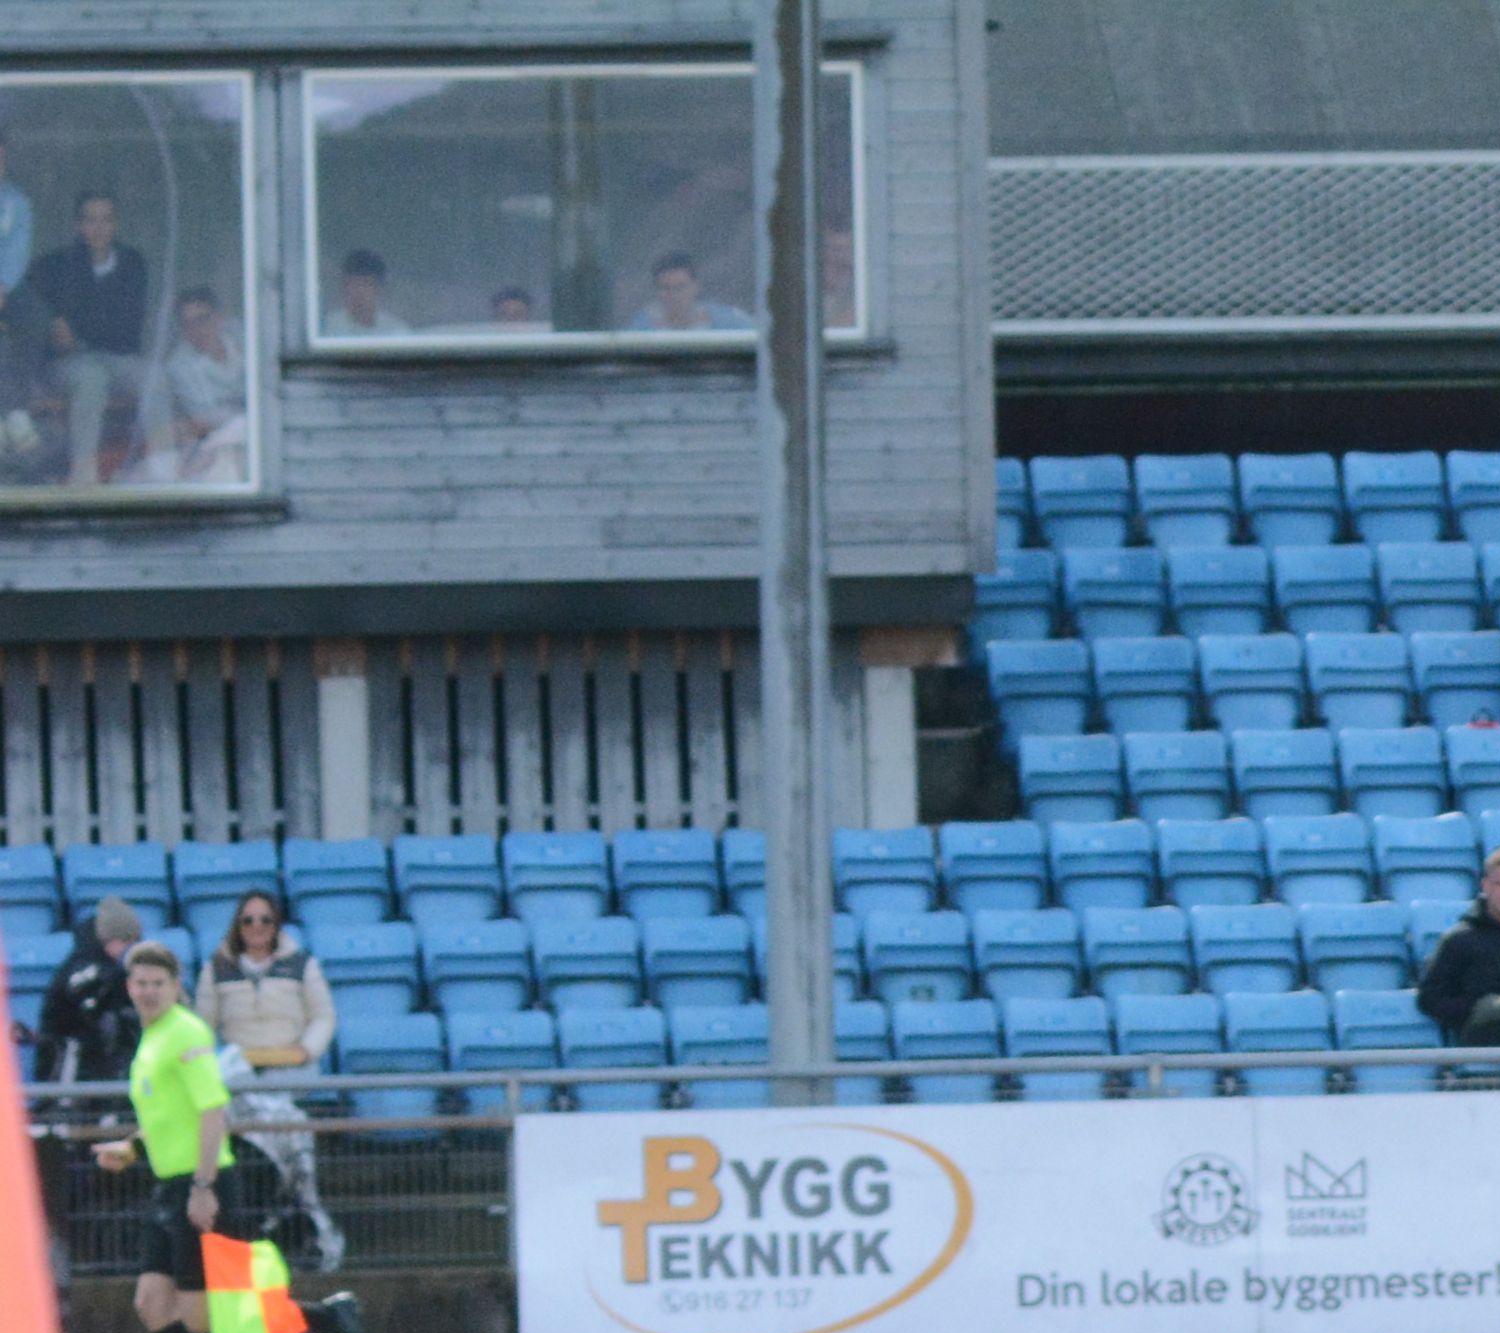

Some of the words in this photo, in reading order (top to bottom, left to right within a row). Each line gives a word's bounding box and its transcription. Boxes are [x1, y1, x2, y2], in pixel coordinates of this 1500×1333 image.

[643, 1136, 891, 1225] BYGG
[597, 1200, 892, 1283] TEKNIKK
[735, 1289, 764, 1311] 27
[773, 1287, 814, 1309] 137
[1016, 1273, 1086, 1308] Din
[1100, 1268, 1229, 1306] lokale
